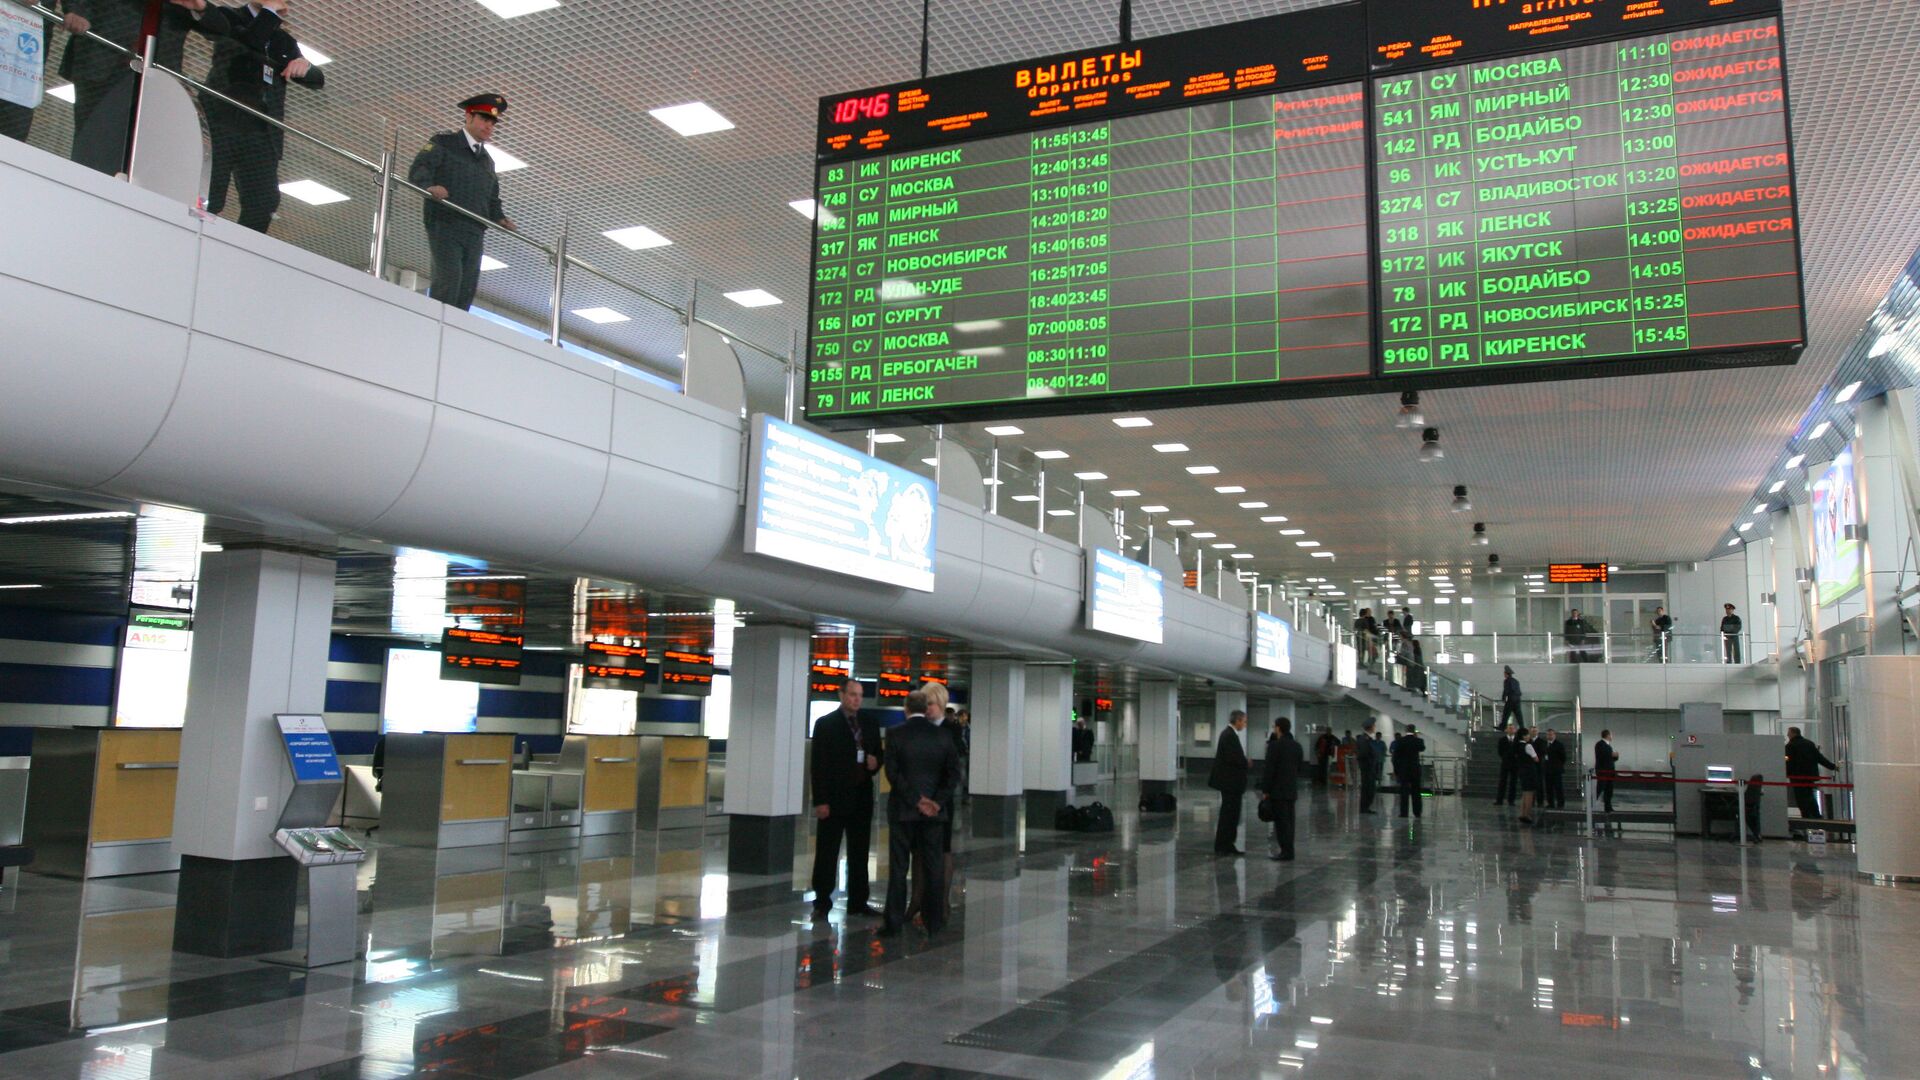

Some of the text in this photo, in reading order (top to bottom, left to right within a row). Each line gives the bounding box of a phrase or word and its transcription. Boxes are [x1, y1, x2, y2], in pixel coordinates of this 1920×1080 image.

[1508, 12, 1592, 30] НАПРАВЛЕНИЕ РЕЙСА
[1623, 8, 1664, 20] arrival time
[1016, 50, 1142, 88] ВЫЛЕТЫ
[1382, 26, 1778, 98] 747 СУ МОСКВА 11:10 ОЖИДАЕТСЯ
[1028, 72, 1132, 98] departures
[1383, 57, 1780, 127] 541 ЯМ МИРНЫЙ 12:30 ОЖИДАЕТСЯ
[835, 93, 890, 123] 1046
[1385, 89, 1782, 155] 142 РД БОДАЙБО 12:30 ОЖИДАЕТСЯ
[828, 92, 1363, 182] 83 ИК КИРЕНСК 11:55 13:45 Регистрация
[823, 120, 1364, 207] 748 СУ МОСКВА 12:40 13:45 Регистрация
[1390, 135, 1673, 184] 96 ИК УСТЬ-КУТ 13:00
[857, 212, 878, 227] ЯМ
[890, 198, 958, 222] МИРНЫЙ
[1032, 186, 1068, 202] 13:10
[1070, 180, 1107, 196] 16:10
[1381, 153, 1788, 214] 3274 С7 ВЛАДИВОСТОК 13:20 ОЖИДАЕТСЯ
[822, 207, 1107, 256] 317 ЯК ЛЕНСК 14:20 18:20
[1387, 185, 1790, 243] 318 ЯК ЛЕНСК 13:25 ОЖИДАЕТСЯ
[816, 234, 1107, 281] 3274 С7 НОВОСИБИРСК 15:40 16:05
[1382, 218, 1792, 273] 9172 ИК ЯКУТСК 14:00 ОЖИДАЕТСЯ
[819, 292, 842, 306] 172
[854, 288, 874, 303] РД
[1031, 266, 1067, 282] 16:25
[1070, 262, 1107, 277] 17:05
[1393, 261, 1682, 302] 78 ИК БОДАЙБО 14:05
[818, 289, 1106, 331] 156 ЮТ СУРГУТ 18:40 23:45
[1390, 294, 1684, 333] 172 РД НОВОСИБИРСК 15:25
[816, 317, 1106, 356] 750 СУ МОСКВА 07:00 08:05
[1384, 326, 1686, 364] 9160 РД КИРЕНСК 15:45
[811, 344, 1106, 382] 9155 РД ЕРБОГАЧЕН 08:30 11:10
[818, 394, 833, 408] 79
[851, 391, 871, 405] ИК
[882, 385, 934, 403] ЛЕНСК
[1068, 372, 1106, 387] 12:40
